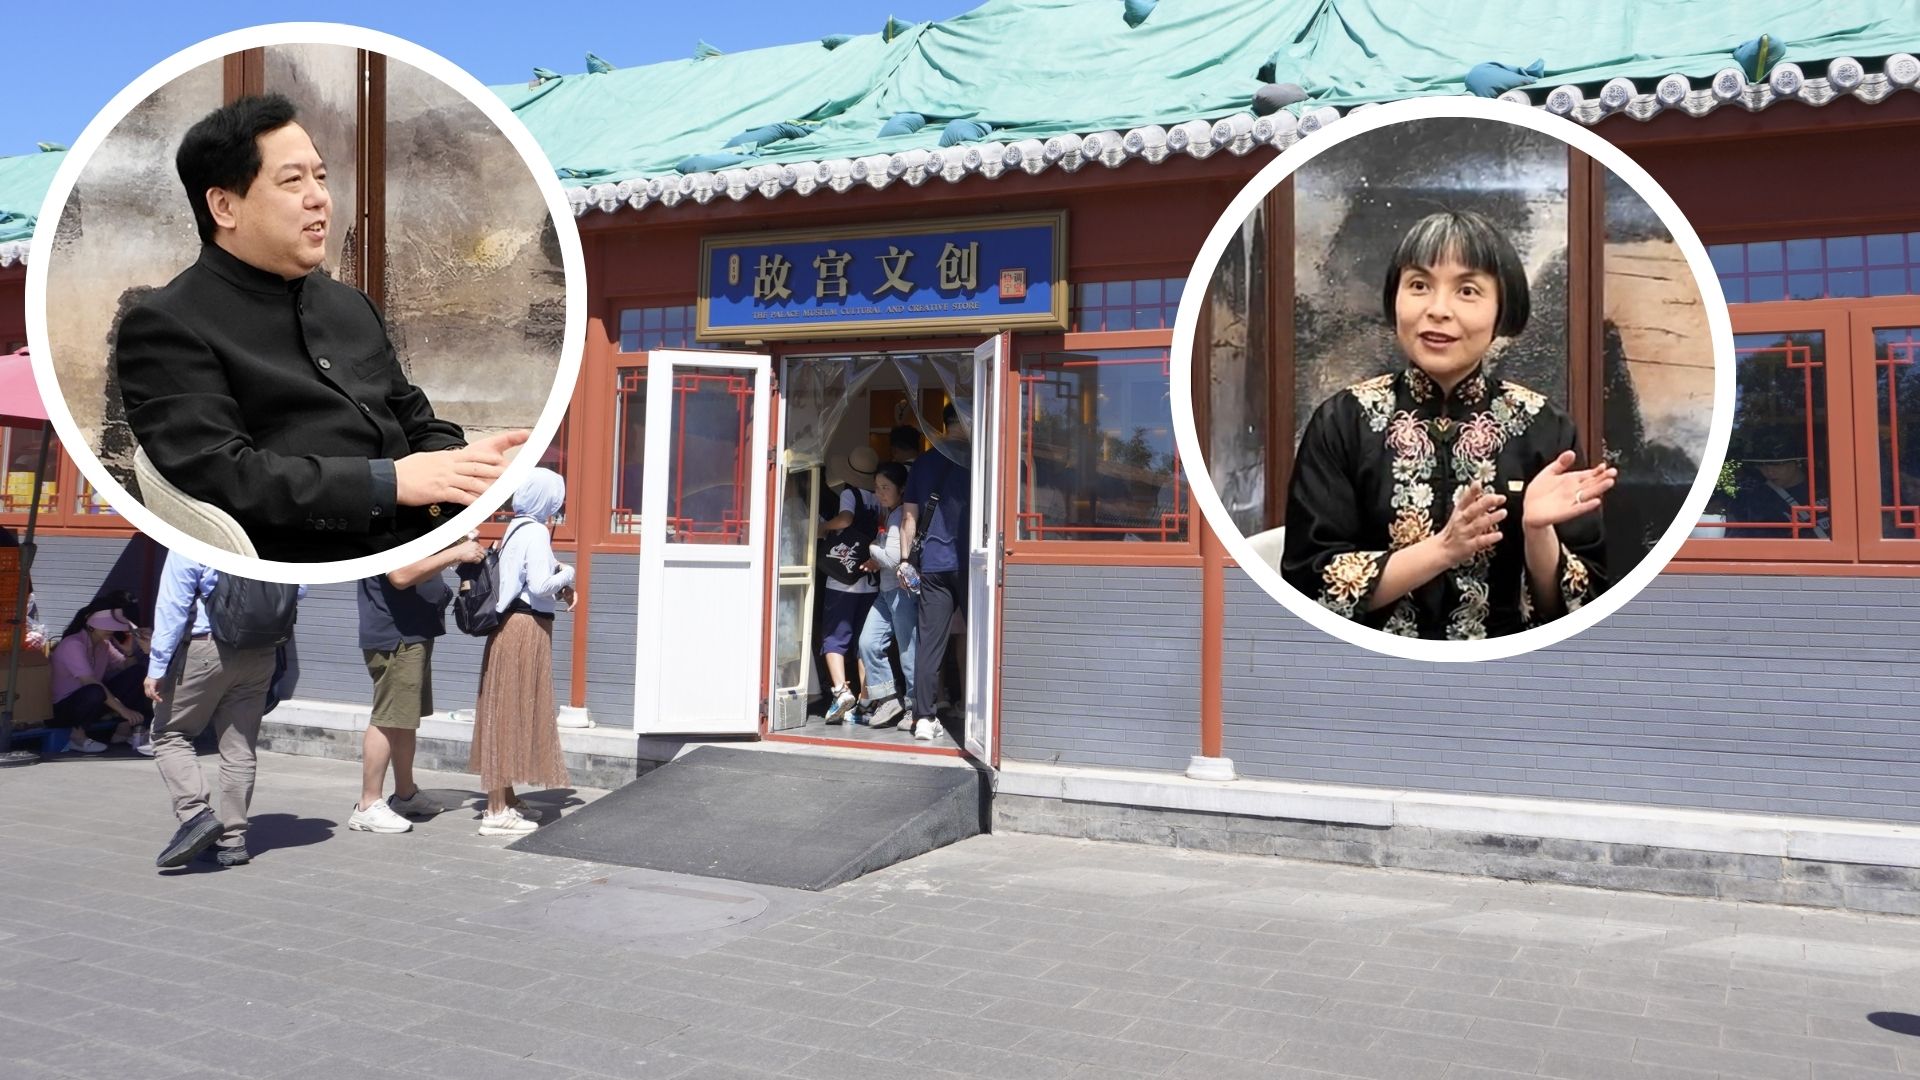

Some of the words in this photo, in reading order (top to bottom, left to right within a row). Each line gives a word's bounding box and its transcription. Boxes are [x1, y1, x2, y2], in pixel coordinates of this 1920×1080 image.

[753, 241, 979, 301] 故宫文创
[753, 311, 768, 320] THE
[770, 310, 800, 319] PALACE
[803, 308, 837, 317] MUSEUM
[841, 305, 881, 315] CULTURAL
[887, 304, 905, 313] AND
[907, 303, 949, 312] CREATIVE
[952, 301, 981, 310] STORE
